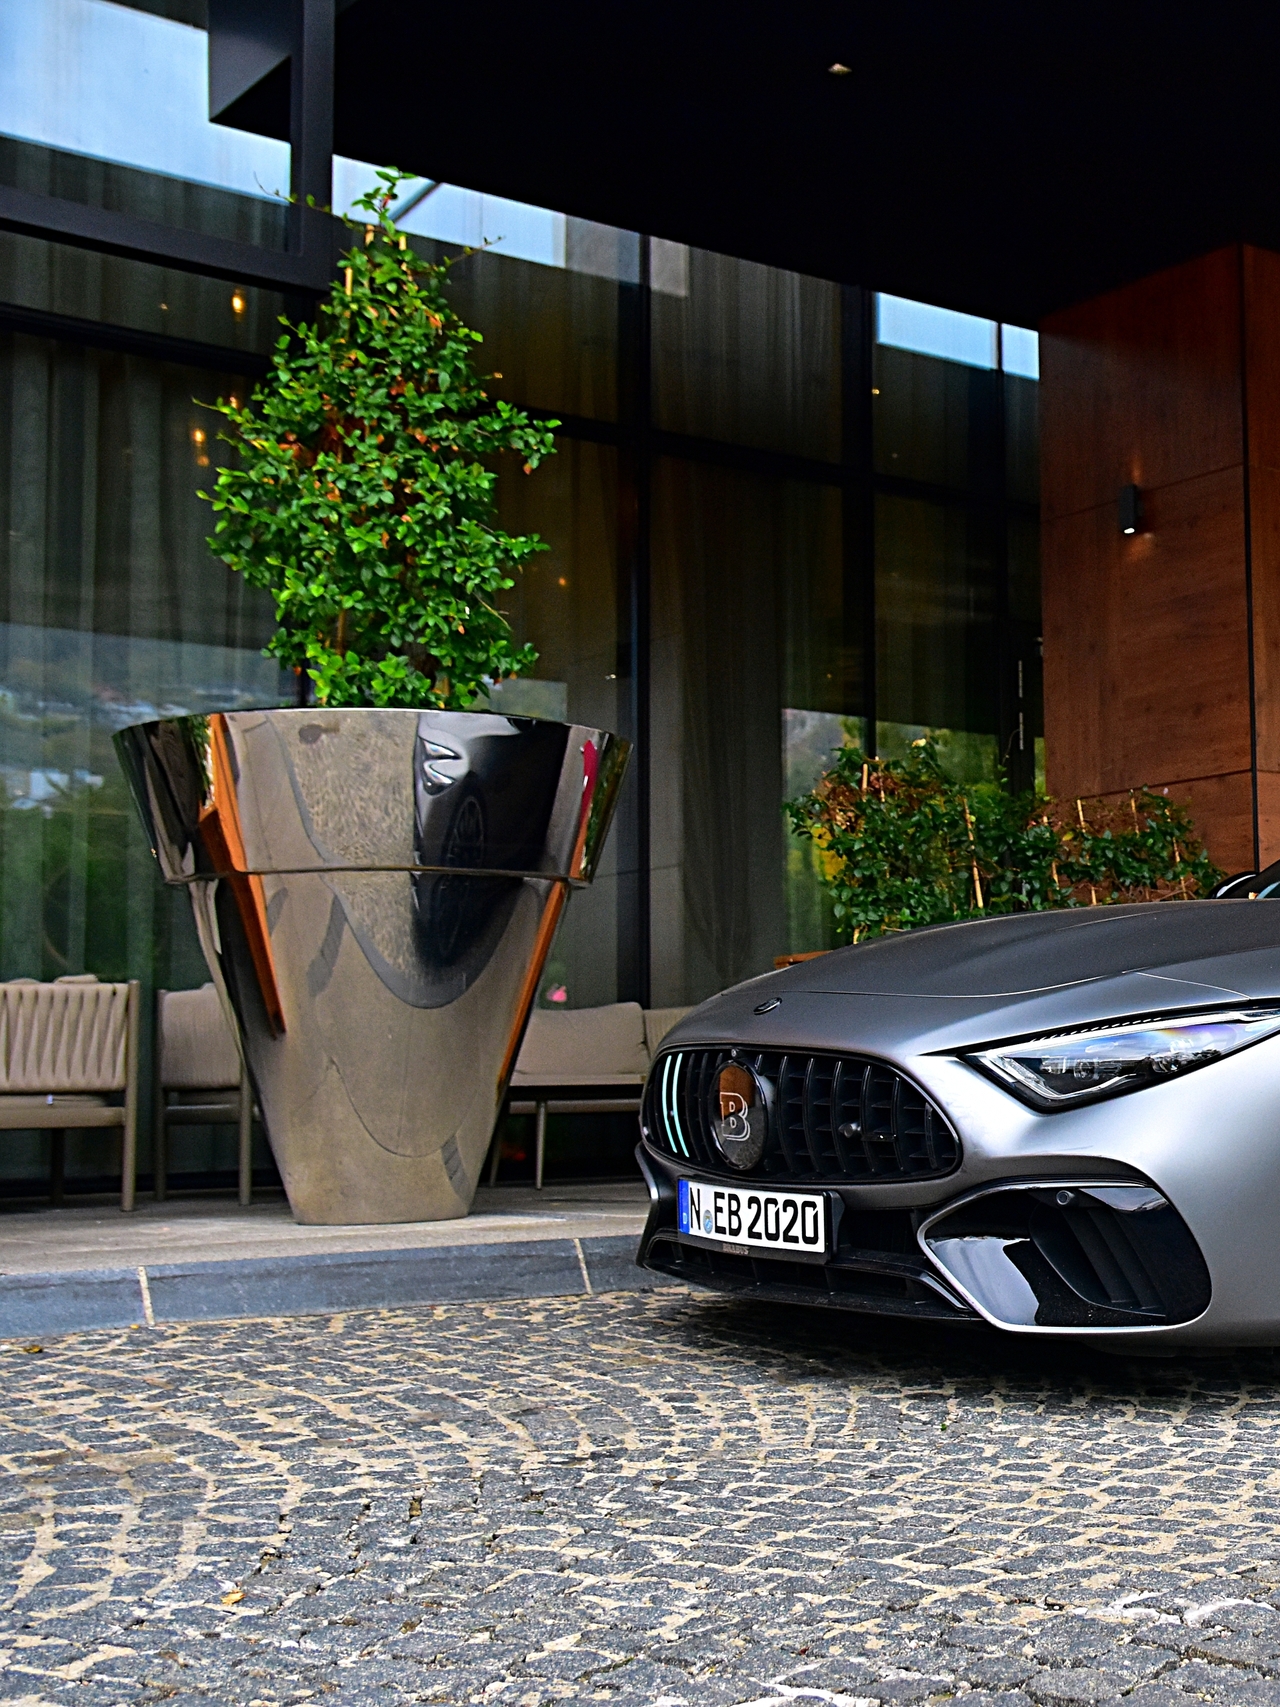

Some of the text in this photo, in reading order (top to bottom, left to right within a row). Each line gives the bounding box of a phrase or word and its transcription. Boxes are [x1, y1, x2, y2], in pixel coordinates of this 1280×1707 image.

[720, 1092, 750, 1141] B
[689, 1187, 819, 1245] N EB 2020
